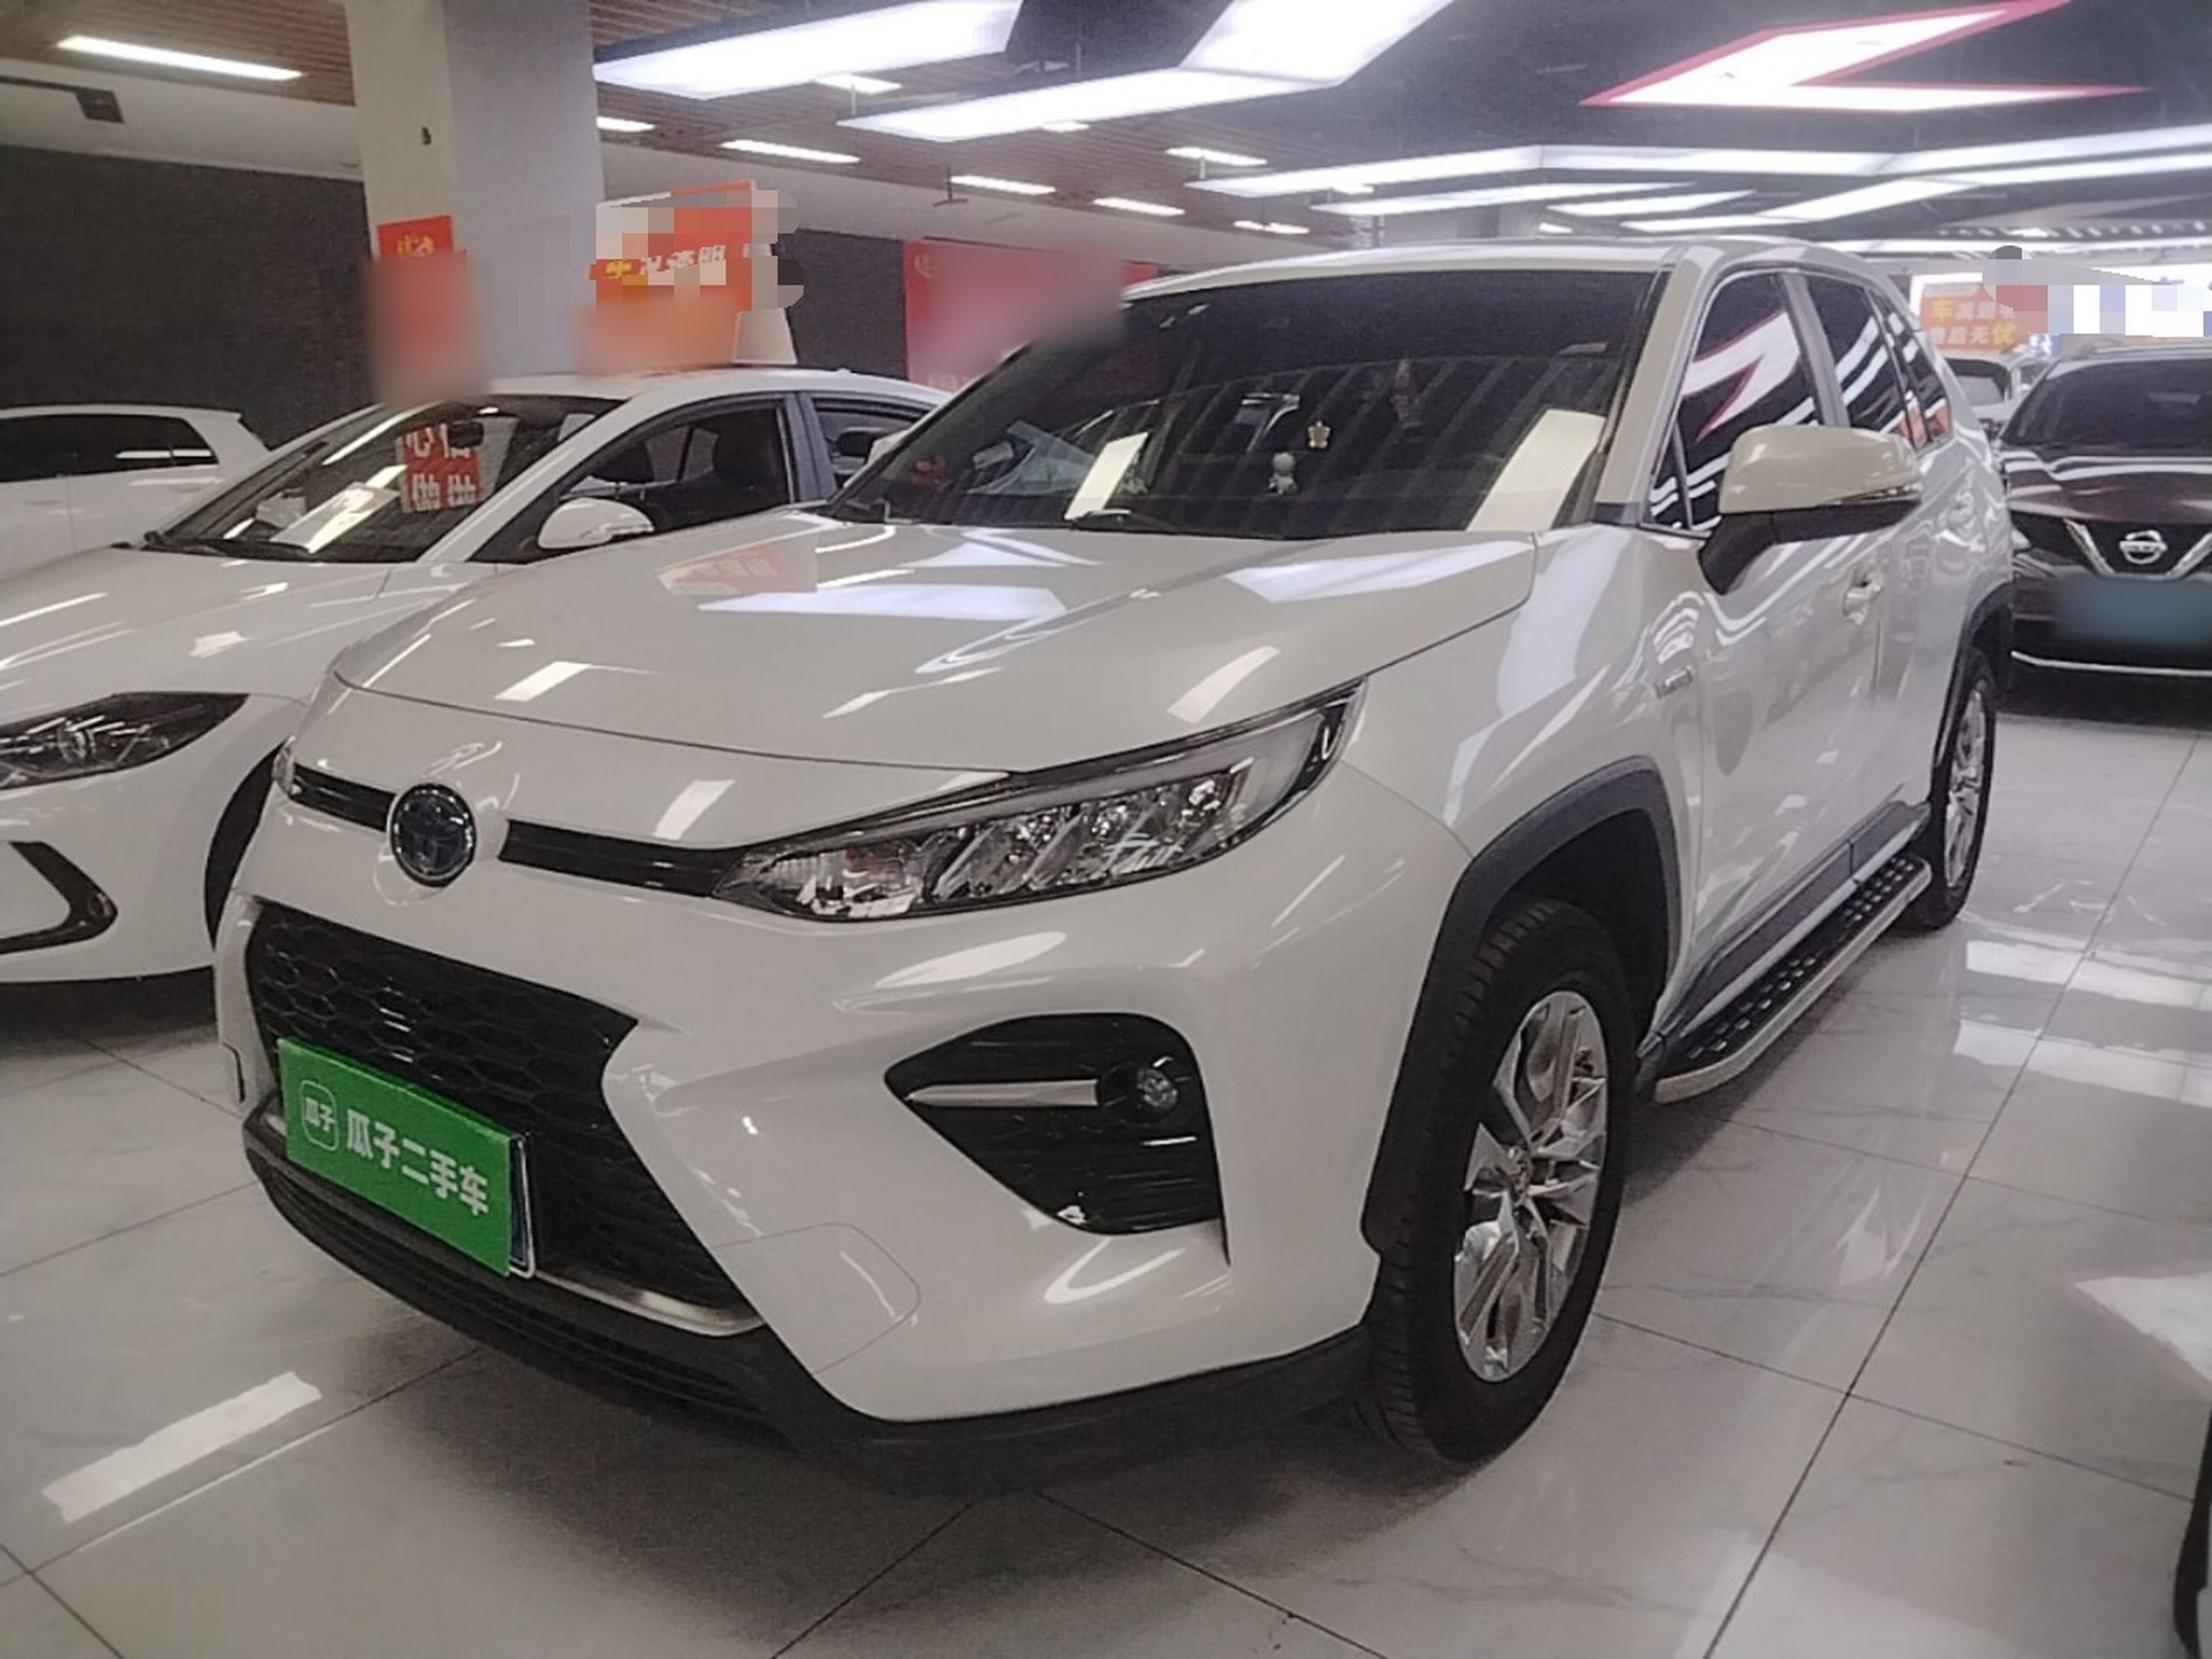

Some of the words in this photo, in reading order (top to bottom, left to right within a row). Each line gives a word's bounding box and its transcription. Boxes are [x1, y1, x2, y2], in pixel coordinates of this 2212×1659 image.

[347, 1108, 489, 1215] 瓜子二手车
